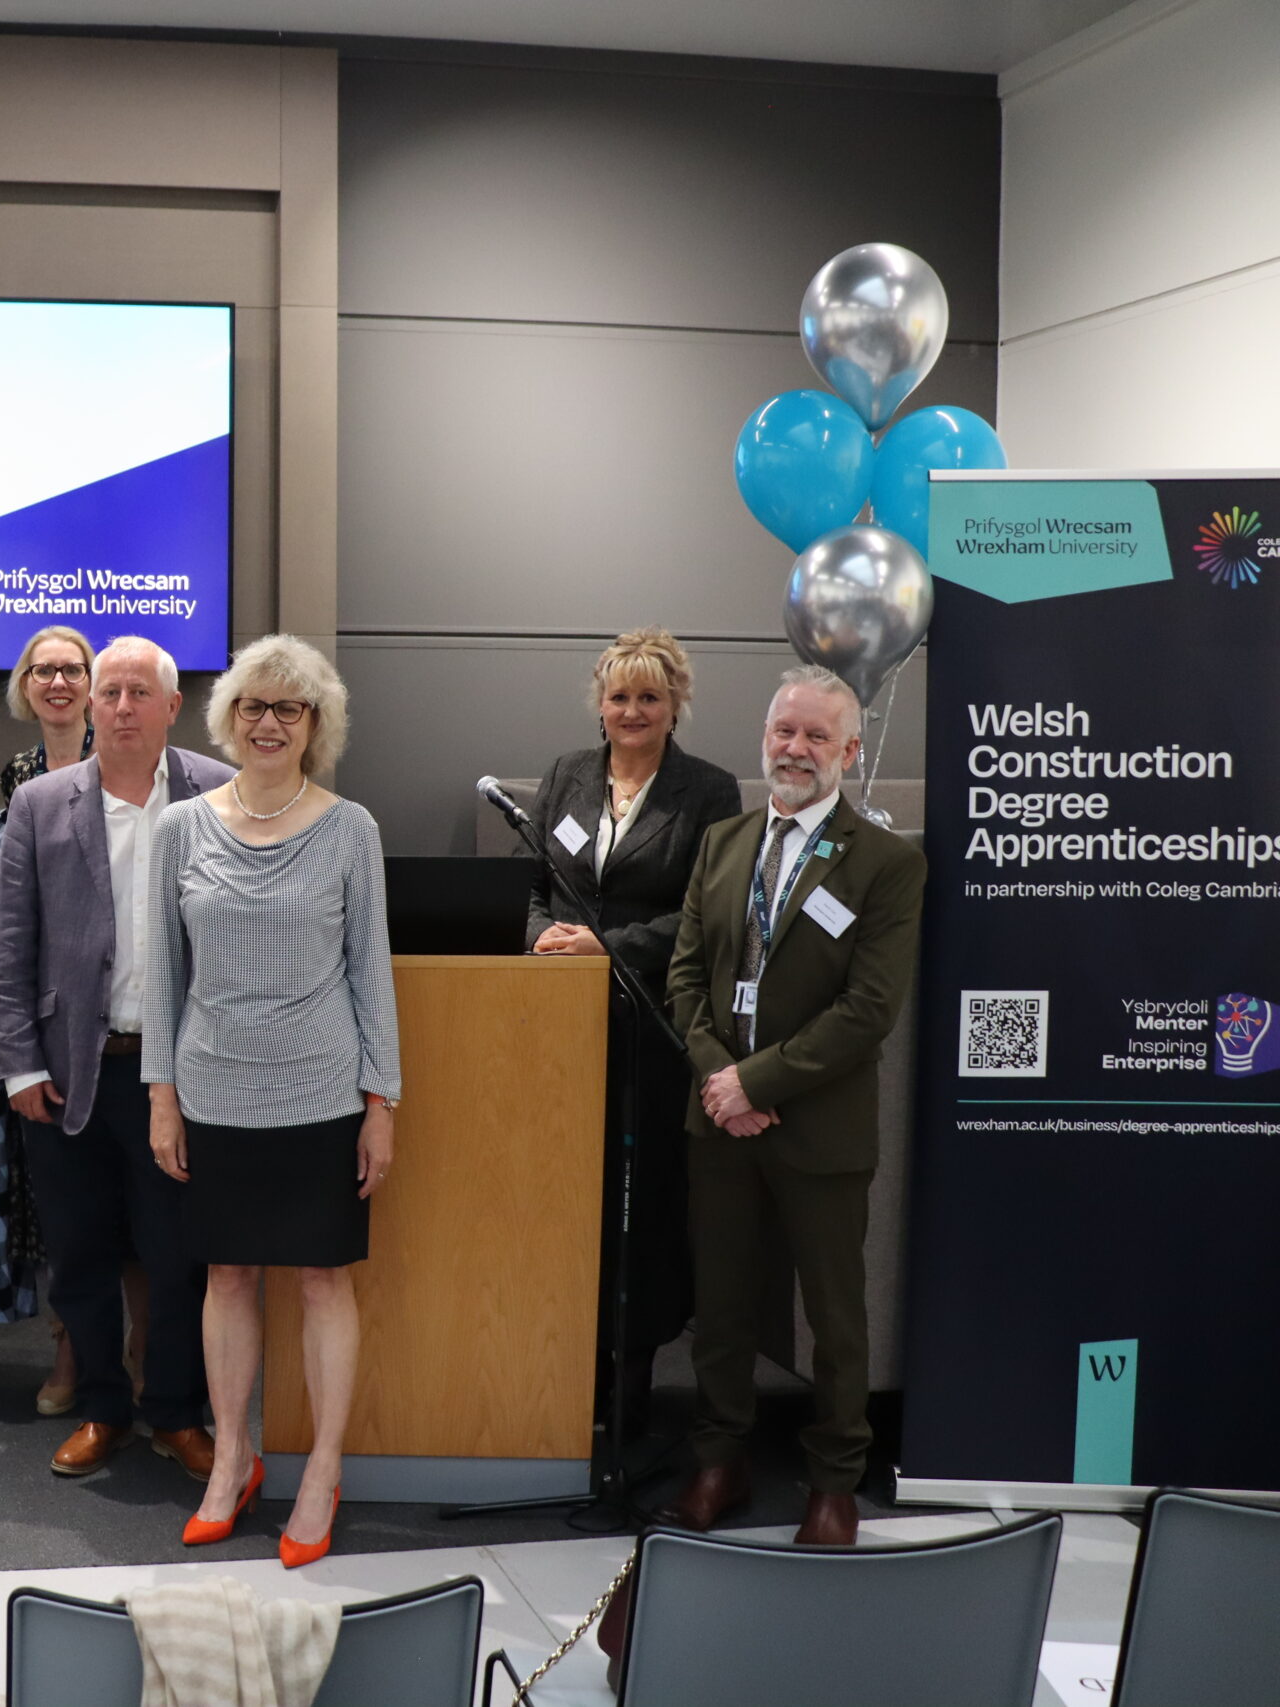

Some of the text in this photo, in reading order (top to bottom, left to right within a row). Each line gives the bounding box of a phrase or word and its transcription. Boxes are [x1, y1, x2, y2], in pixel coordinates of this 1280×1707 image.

[964, 516, 1133, 538] Prifysgol Wrecsam
[956, 538, 1139, 558] Wrexham University
[1256, 546, 1280, 559] CA
[87, 570, 189, 590] Wrecsam
[92, 595, 196, 619] University
[968, 702, 1089, 736] Welsh
[969, 744, 1232, 778] Construction
[969, 787, 1108, 827] Degree
[966, 881, 1280, 901] in partnership with Coleg Cambri
[1122, 1000, 1208, 1016] Ysbrydoli
[1136, 1016, 1208, 1031] Menter
[1128, 1038, 1207, 1055] Inspiring
[1102, 1054, 1207, 1072] Enterprise
[1086, 1352, 1128, 1384] W
